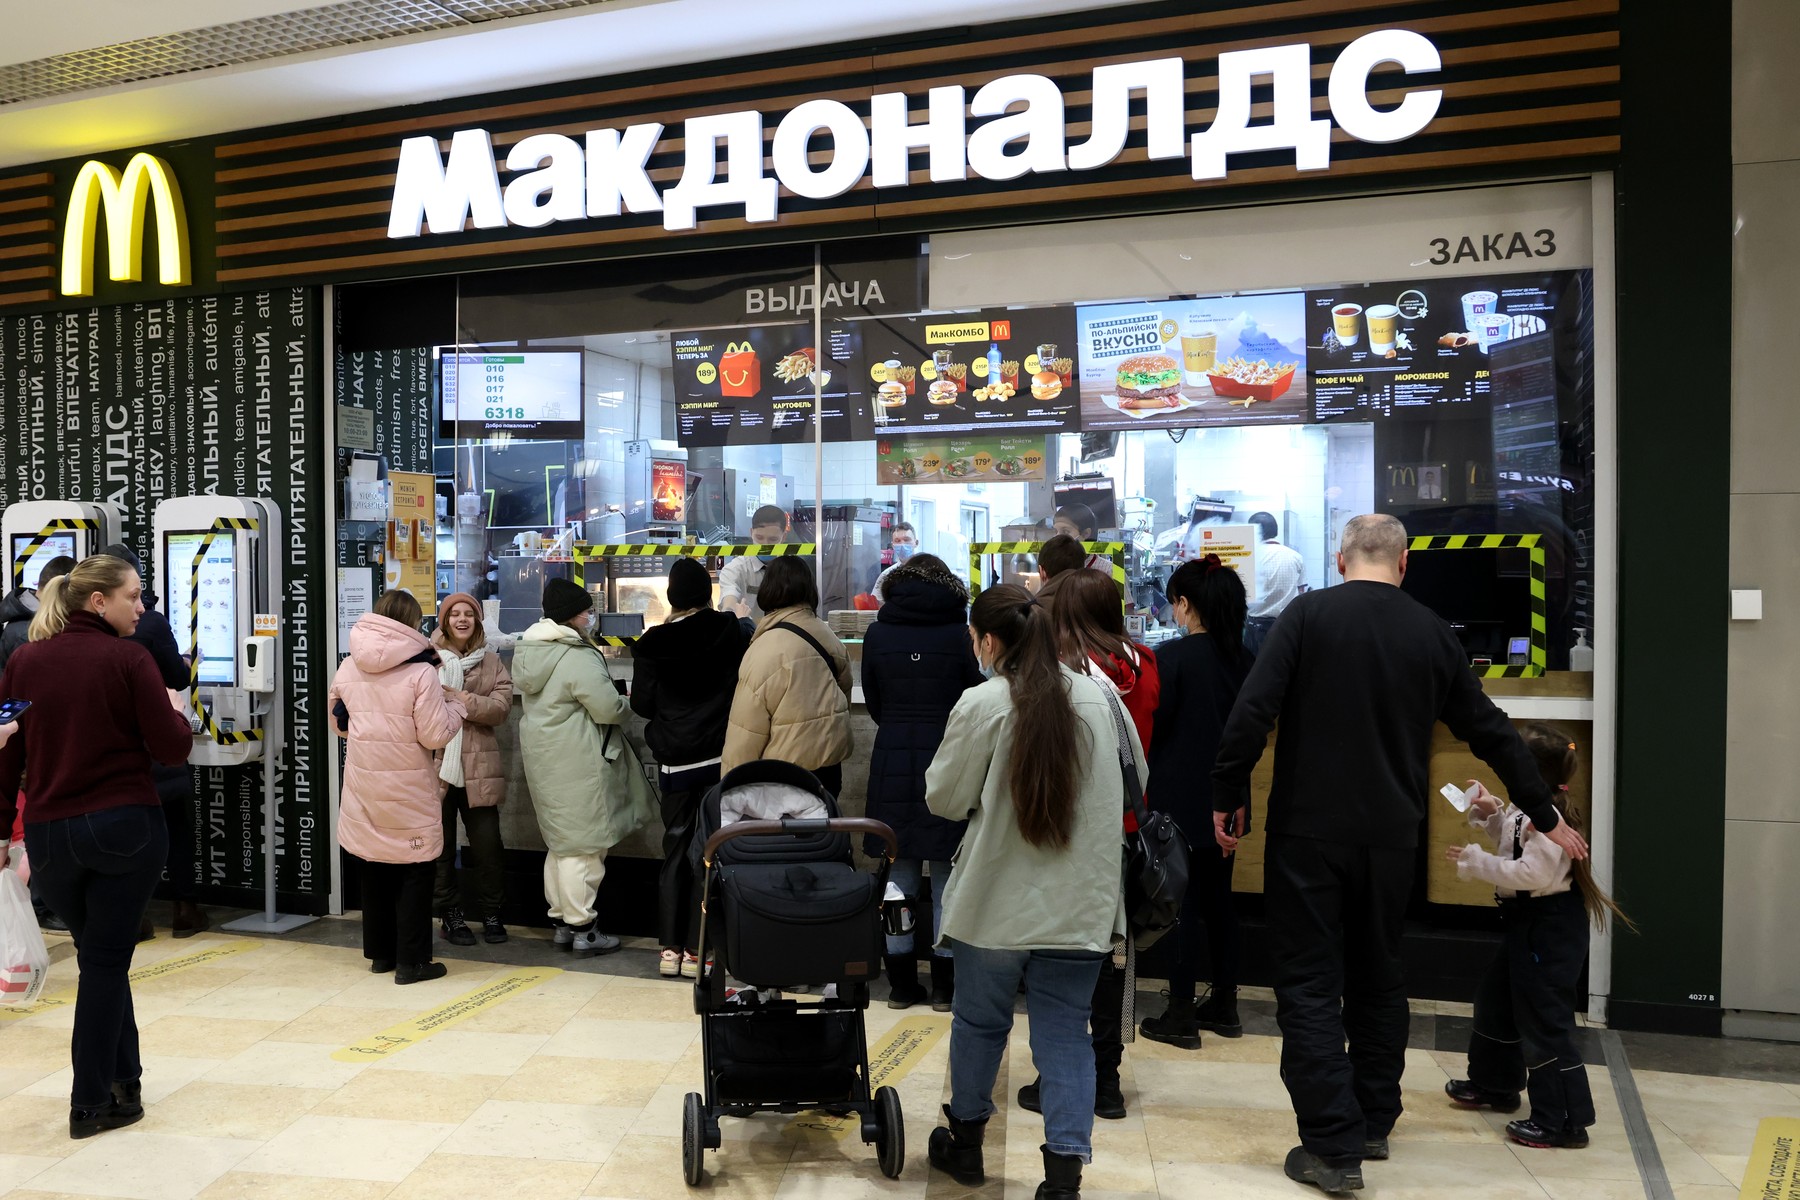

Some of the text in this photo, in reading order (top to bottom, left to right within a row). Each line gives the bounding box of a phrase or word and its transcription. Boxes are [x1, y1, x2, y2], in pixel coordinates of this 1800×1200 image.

[1428, 228, 1557, 266] ЗАКАЗ
[746, 278, 885, 315] ВЫДАЧА
[55, 319, 64, 352] ВКУС,
[148, 308, 162, 339] ВП
[166, 326, 176, 344] life,
[186, 306, 195, 380] aconchegante,
[202, 297, 218, 371] auténti
[676, 338, 700, 347] ЛЮБОЙ
[930, 328, 984, 339] МакКОМБО
[1092, 321, 1158, 338] ПО-АЛЬПИЙСКИ
[1092, 331, 1158, 351] ВКУСНО
[134, 316, 145, 388] autentico,
[232, 320, 246, 394] amigable,
[676, 346, 698, 354] ХЭППИ
[65, 313, 80, 430] ВПЕЧАТЛЯ
[114, 350, 124, 398] balanced,
[149, 346, 166, 435] laughing,
[167, 346, 176, 398] humanisé,
[1316, 374, 1364, 384] КОФЕ И ЧАЙ
[1394, 372, 1450, 381] МОРОЖЕНОЕ
[17, 364, 29, 456] simplicidade,
[54, 355, 65, 452] ВПЕЧАТЛЯЮЩИЙ
[374, 374, 384, 415] roots,
[484, 407, 524, 419] 6318
[680, 402, 702, 410] ХЭППИ
[772, 402, 812, 410] КАРТОФЕЛЬ
[28, 370, 46, 500] ОСТУПНЫЙ,
[90, 398, 101, 438] team,
[168, 401, 178, 454] qualitativo,
[184, 382, 195, 454] ЗНАКОМЫЙ,
[234, 399, 246, 442] team,
[418, 396, 428, 460] ВСЕГДА
[132, 393, 146, 525] НАТУРАЛЬНЫЙ,
[286, 334, 308, 565] ПРИТЯГАТЕЛЬНЫЙ,
[169, 458, 178, 498] savoury,
[188, 456, 196, 496] ДАВНО
[288, 574, 310, 802] ПРИТЯГАТЕЛЬНЫЙ,
[239, 775, 254, 872] responsibility
[296, 811, 314, 893] htening,
[1769, 1136, 1793, 1178] СОБЛЮДАЙТЕ
